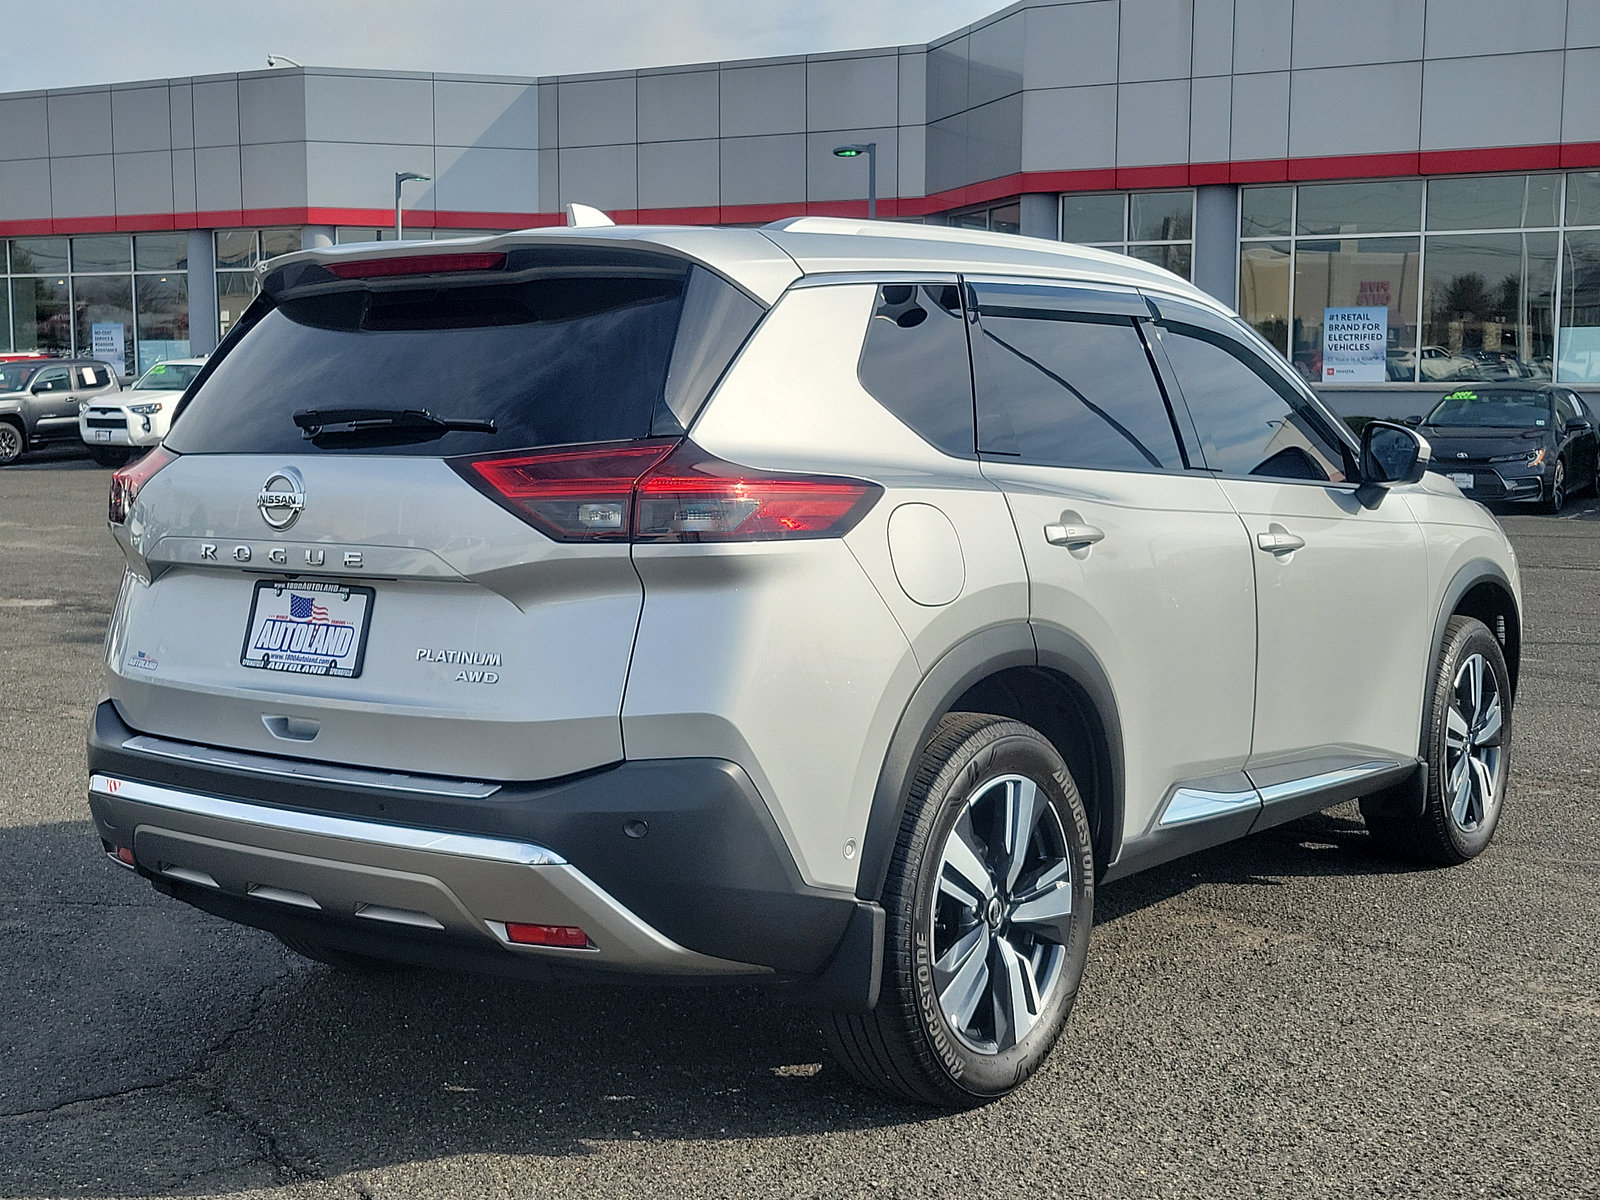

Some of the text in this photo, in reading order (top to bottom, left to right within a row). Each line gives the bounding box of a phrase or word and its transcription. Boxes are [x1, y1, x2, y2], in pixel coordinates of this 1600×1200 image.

[1340, 313, 1370, 321] RETAIL
[1362, 323, 1380, 331] FOR
[1328, 333, 1383, 341] ELECTRIFIED
[1328, 343, 1370, 351] VEHICLES
[259, 495, 297, 504] NISSAN
[200, 543, 363, 568] ROGUE
[254, 618, 355, 658] AUTOLAND
[416, 648, 502, 667] PLATINUM
[267, 660, 327, 675] AUTOLAND
[454, 670, 499, 684] AWD
[1052, 767, 1094, 898] BRIDGESTONE
[916, 932, 966, 1080] BRIDGESTONE
